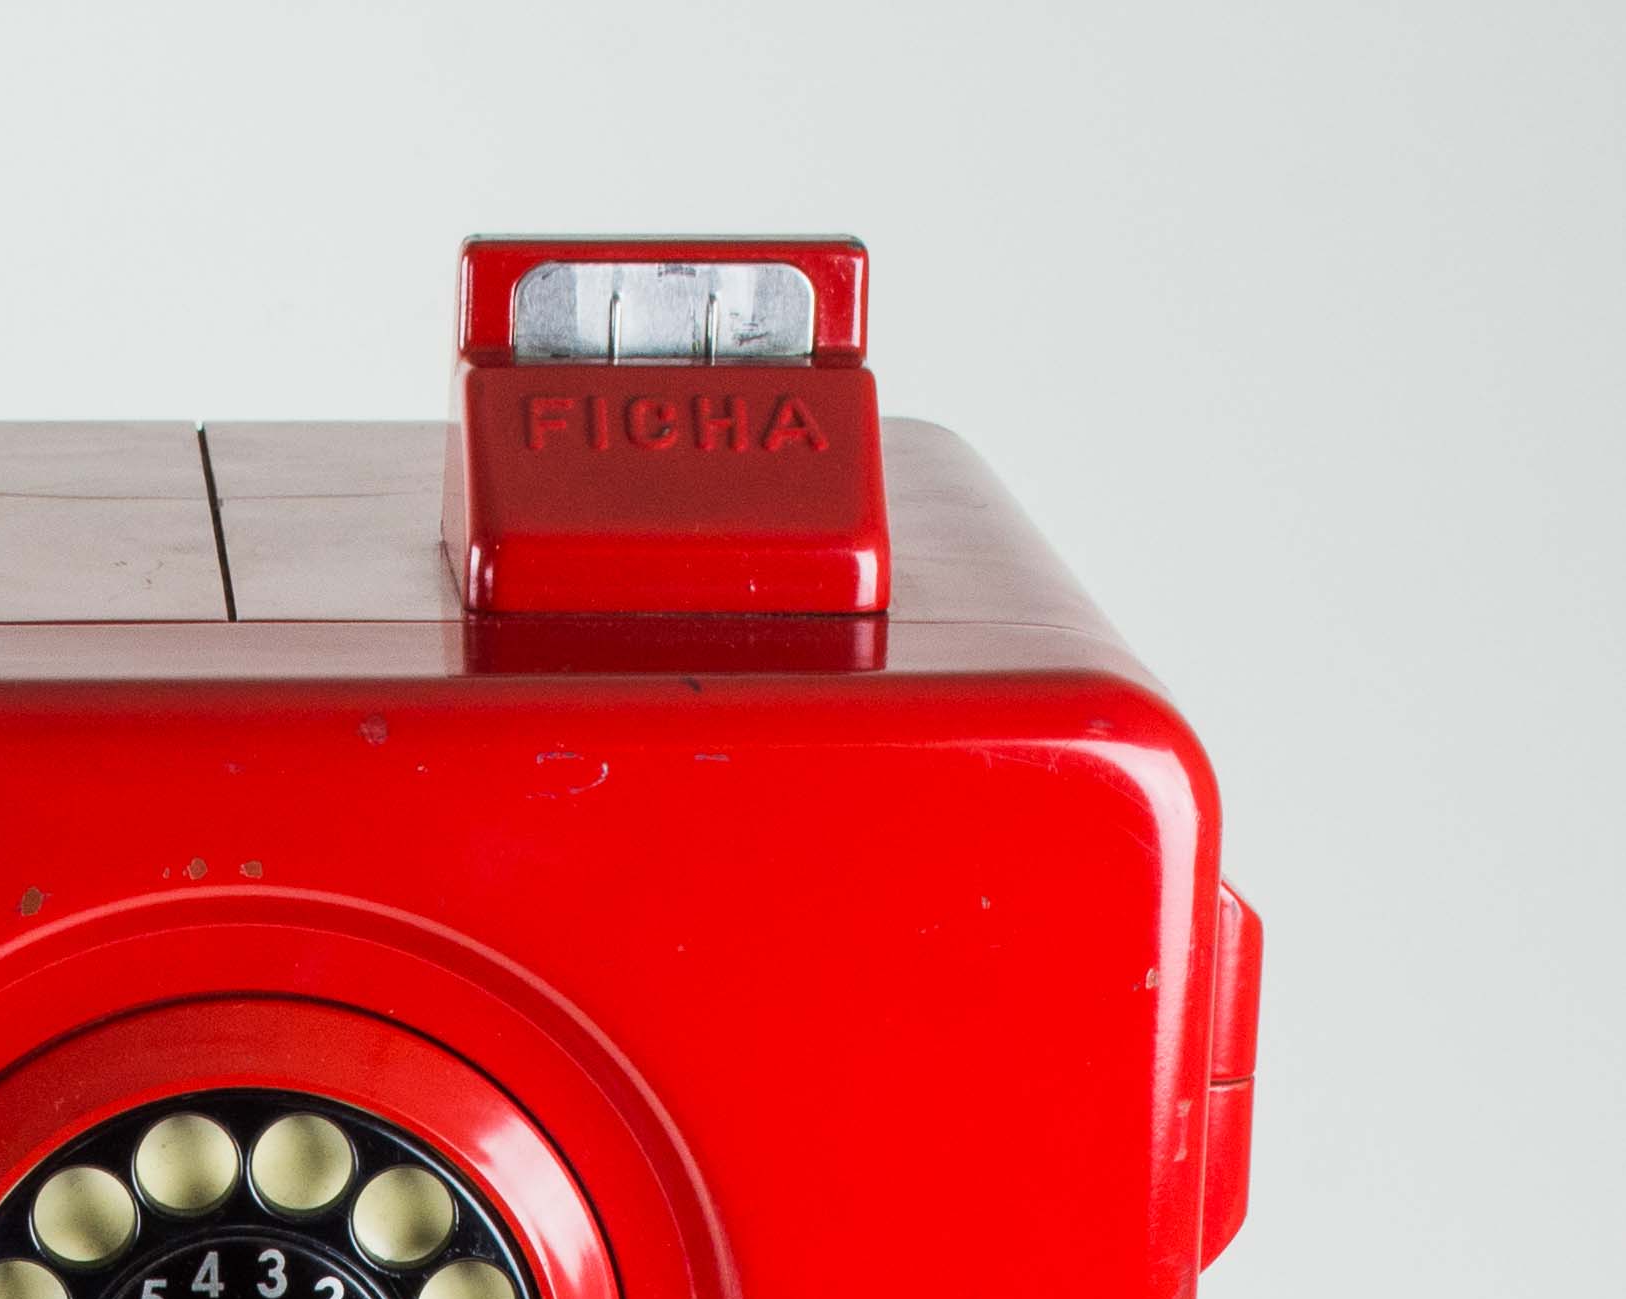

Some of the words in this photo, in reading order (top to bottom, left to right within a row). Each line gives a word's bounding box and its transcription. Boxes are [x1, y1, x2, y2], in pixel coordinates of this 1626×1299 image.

[521, 396, 829, 452] FICHA
[191, 1251, 225, 1298] 4
[257, 1249, 288, 1299] 3
